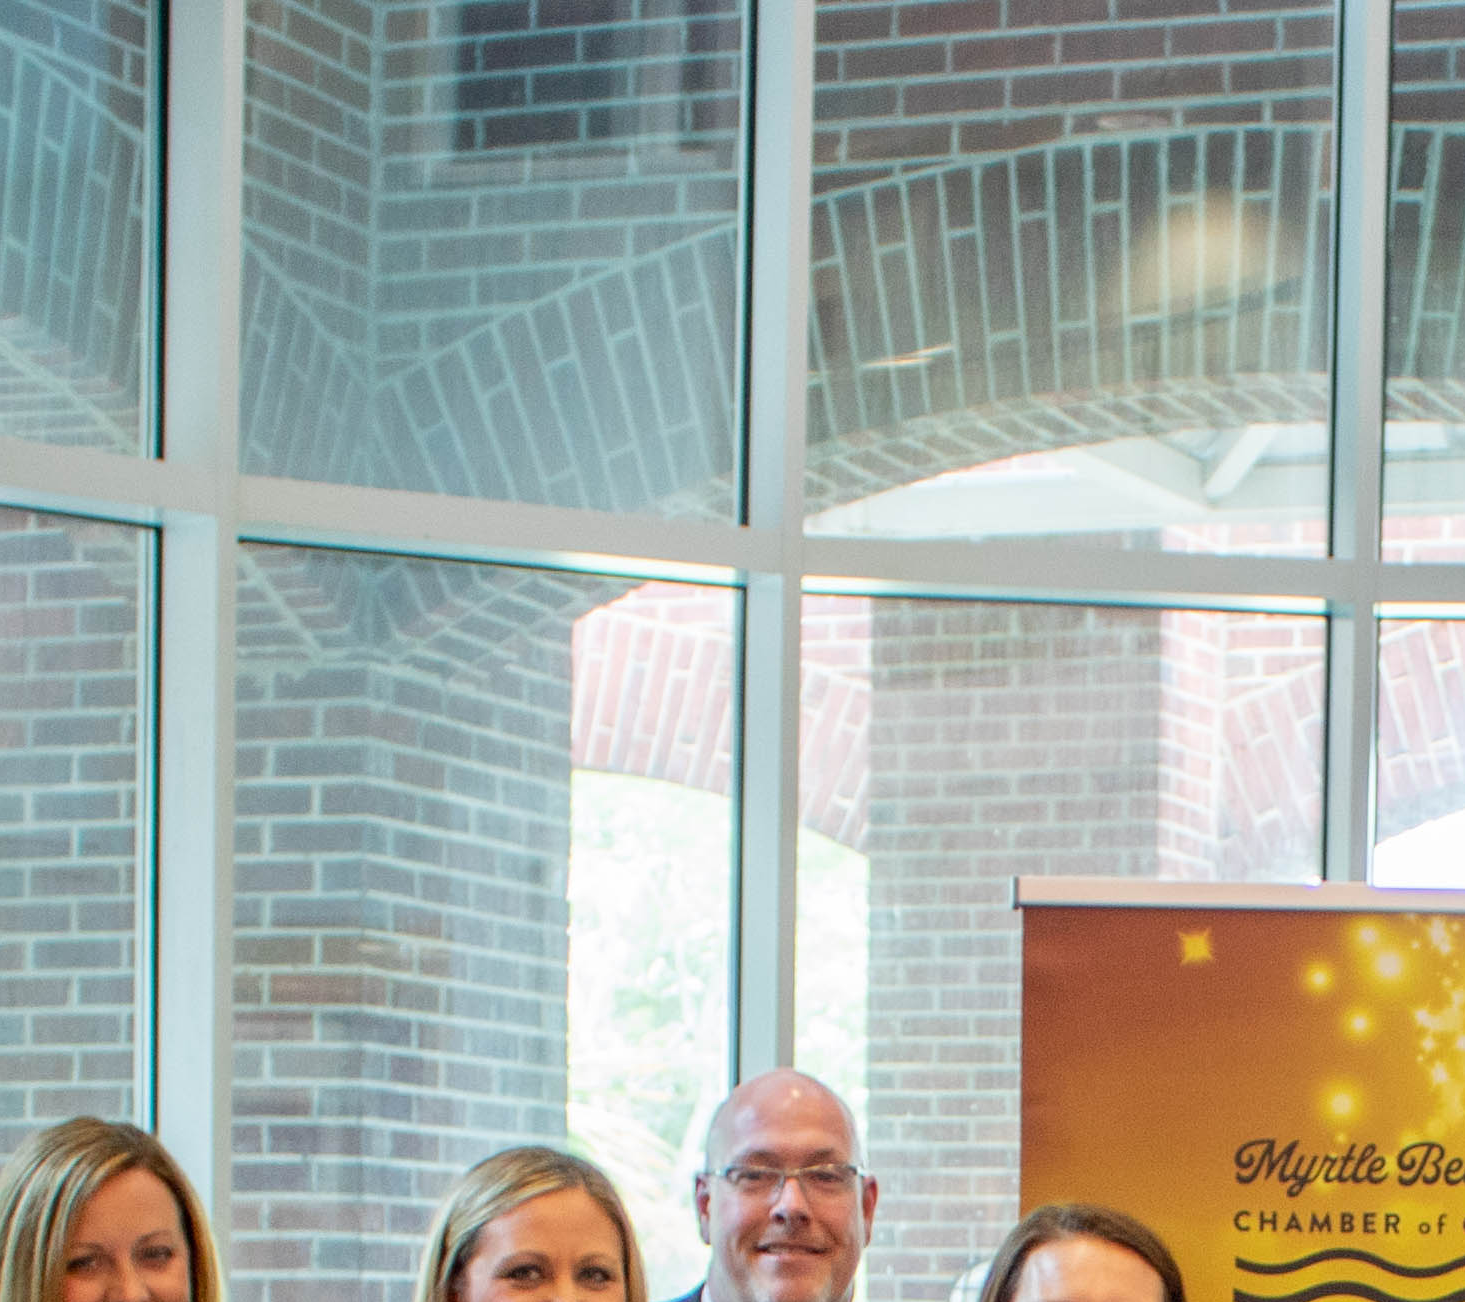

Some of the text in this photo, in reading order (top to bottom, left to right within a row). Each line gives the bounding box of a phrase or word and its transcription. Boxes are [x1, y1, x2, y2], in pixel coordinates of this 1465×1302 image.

[1234, 1138, 1388, 1197] Myrtle
[1233, 1210, 1401, 1234] CHAMBER
[1418, 1213, 1447, 1235] of
